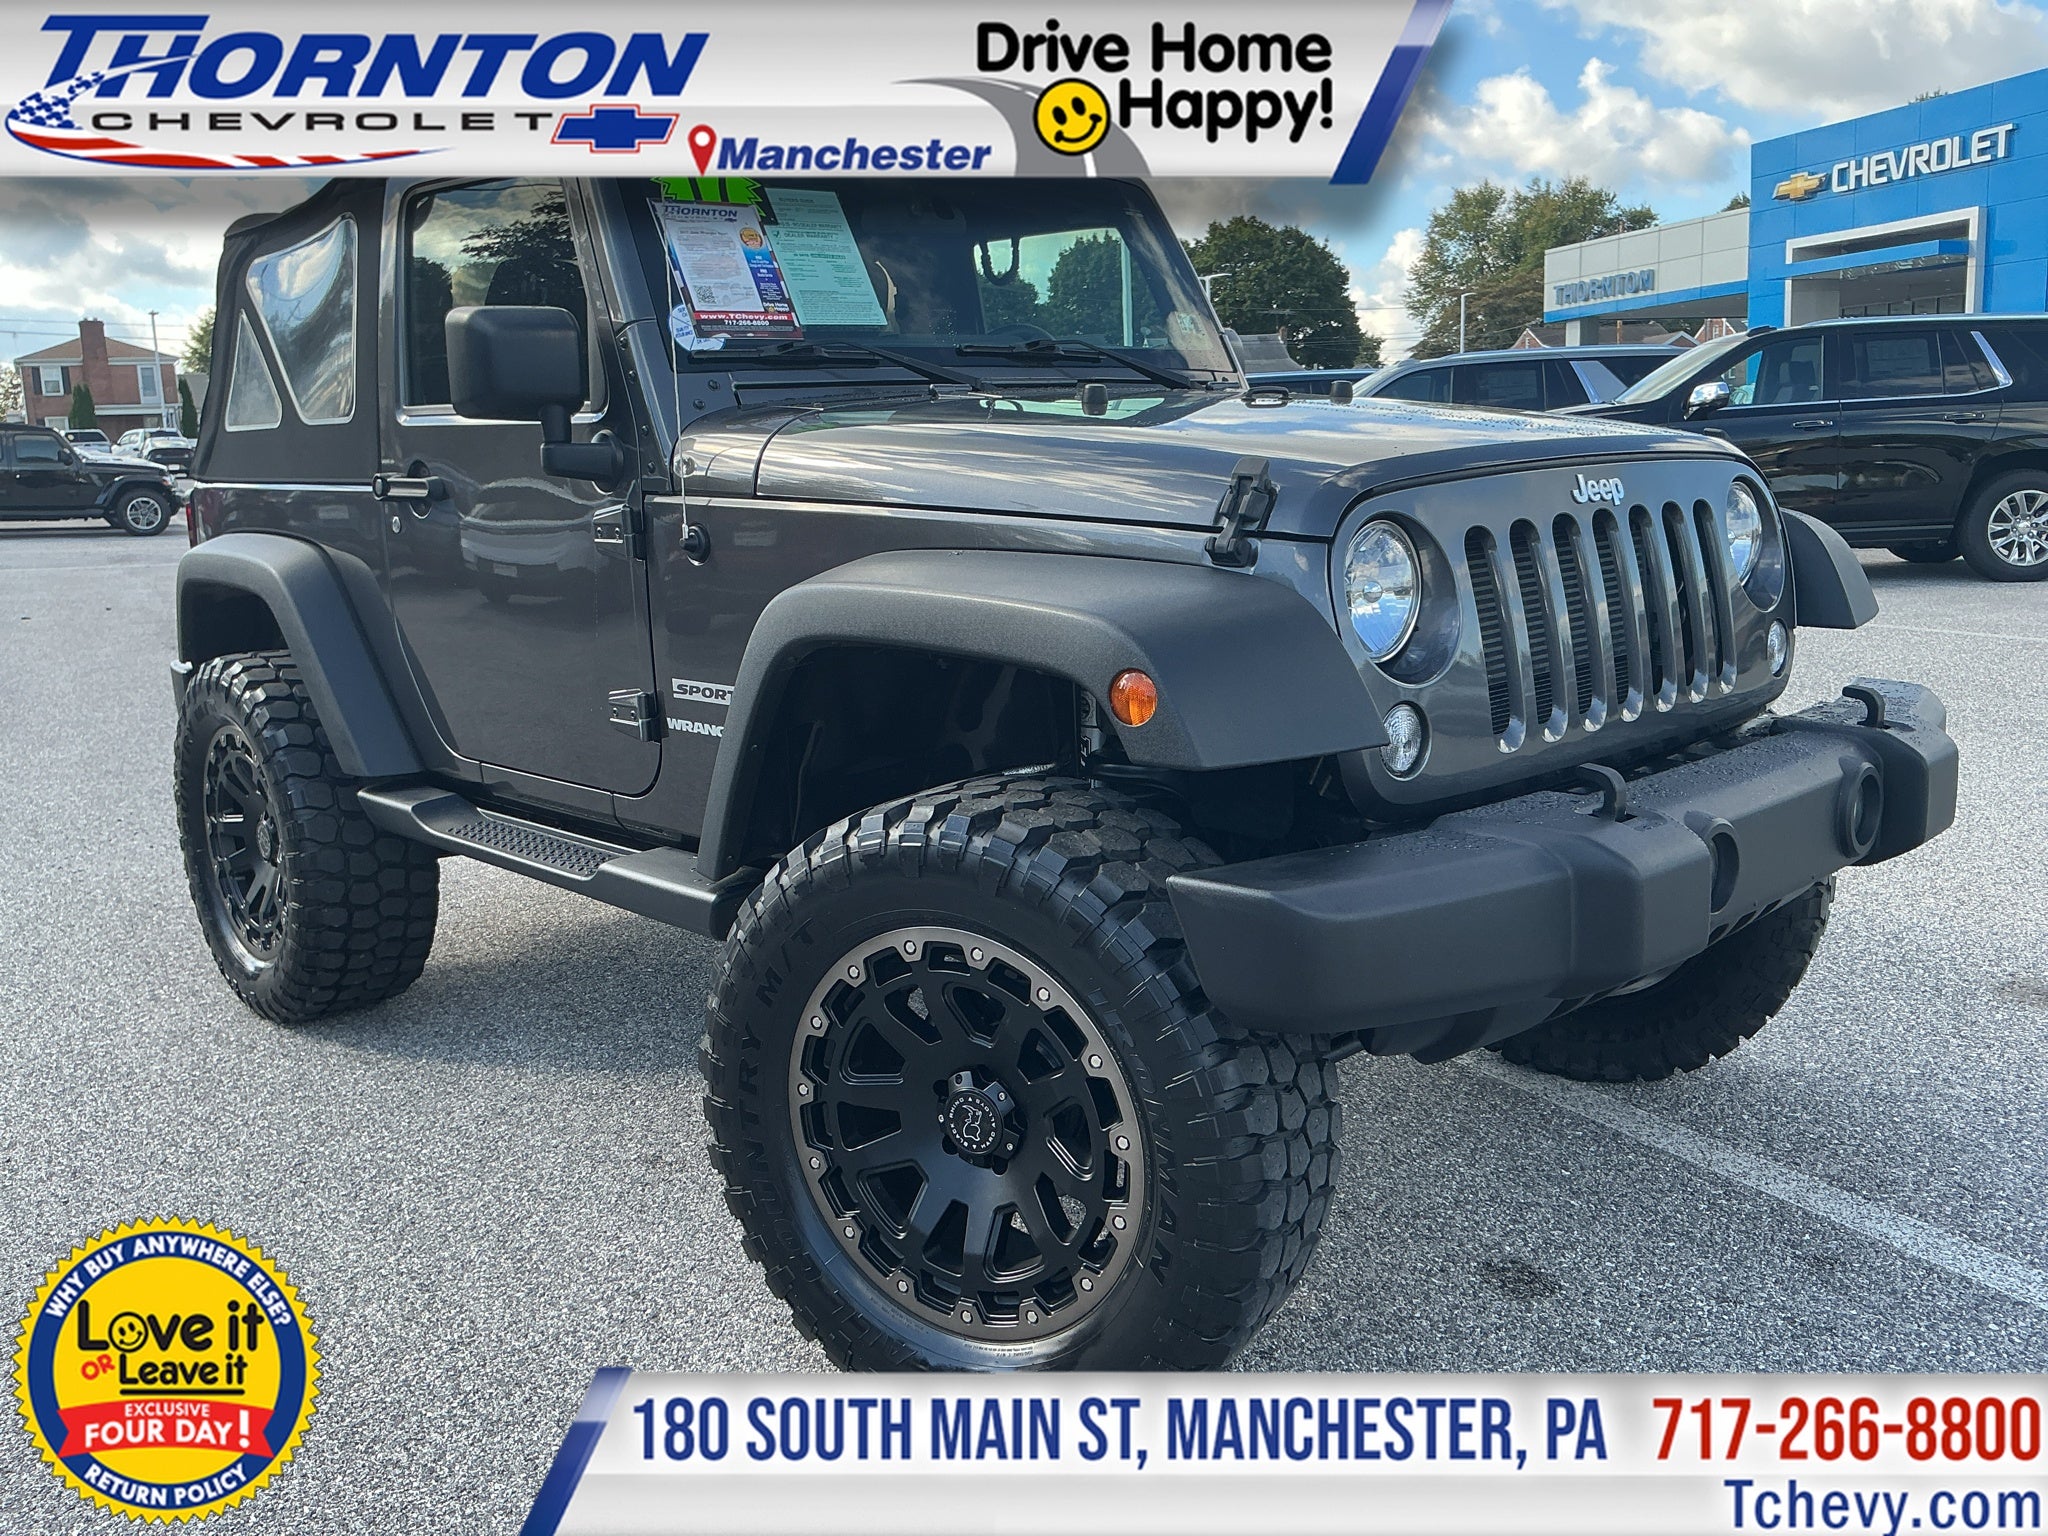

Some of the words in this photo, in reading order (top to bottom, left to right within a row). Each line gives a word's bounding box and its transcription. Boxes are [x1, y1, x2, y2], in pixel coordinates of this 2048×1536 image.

[1831, 122, 2016, 193] CHEVROLET
[664, 205, 738, 217] THORNTON
[1553, 269, 1655, 305] THORNTON
[1573, 473, 1625, 505] Jeep
